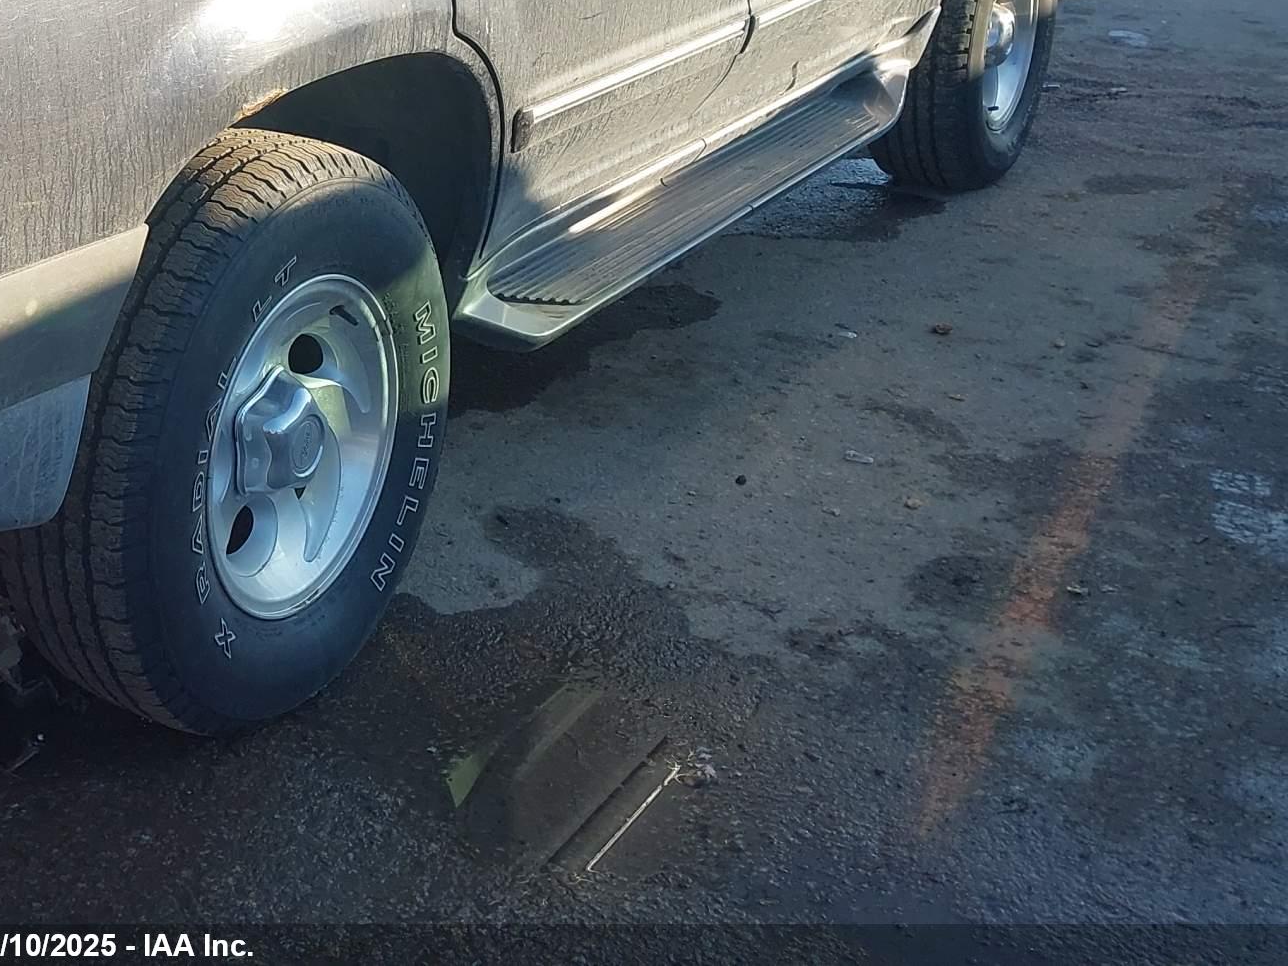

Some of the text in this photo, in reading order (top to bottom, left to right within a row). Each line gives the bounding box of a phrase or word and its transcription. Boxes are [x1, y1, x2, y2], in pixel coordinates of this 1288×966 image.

[191, 353, 237, 605] RADIAL
[371, 300, 440, 592] MICHELIN
[214, 618, 236, 659] X
